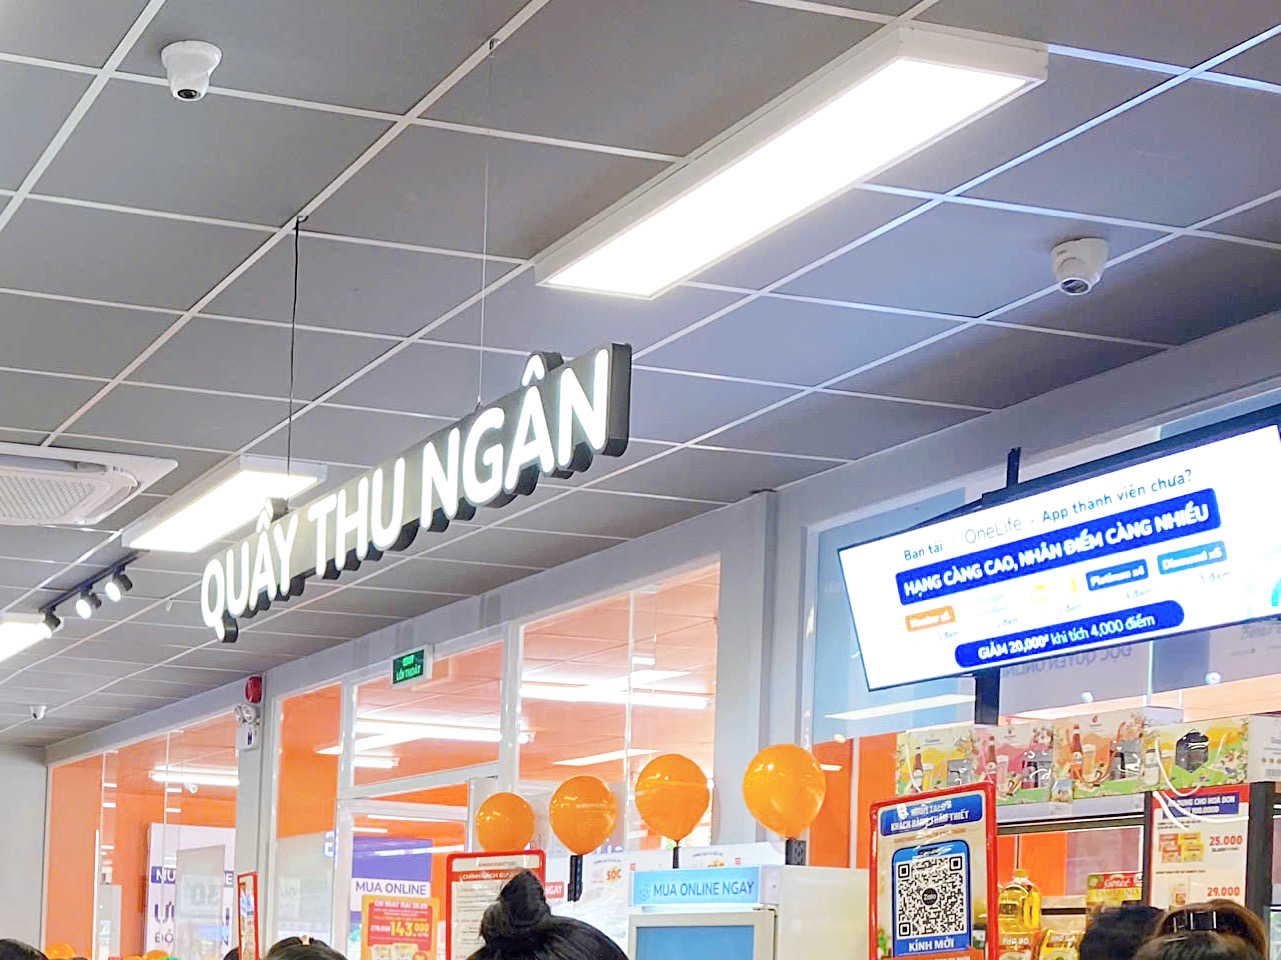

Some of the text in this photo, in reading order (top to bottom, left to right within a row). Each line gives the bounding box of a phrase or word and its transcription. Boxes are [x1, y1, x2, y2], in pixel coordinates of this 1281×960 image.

[201, 350, 609, 642] QUẦY THU NGÂN
[965, 517, 1022, 544] OneLife
[1042, 506, 1068, 524] App
[1072, 494, 1112, 514] thành
[1151, 469, 1192, 492] chưa?
[904, 574, 943, 597] HẠNG
[943, 565, 983, 587] CÀNG
[984, 555, 1018, 576] CAO,
[1019, 542, 1062, 567] NHÂN
[1063, 529, 1104, 555] ĐIỂM
[1106, 520, 1153, 545] CÀNG
[978, 645, 1008, 660] GIẢM
[1051, 631, 1068, 645] khi
[1069, 628, 1090, 642] tích
[1090, 620, 1124, 639] 4,000
[1125, 612, 1156, 629] điểm
[1209, 835, 1243, 847] 25.000
[355, 882, 426, 896] MUA ONLINE
[545, 885, 562, 895] NGAY
[654, 881, 754, 896] MUA ONLINE NGAY
[1207, 886, 1240, 897] 29.000
[909, 936, 955, 952] KÍNH MỜI
